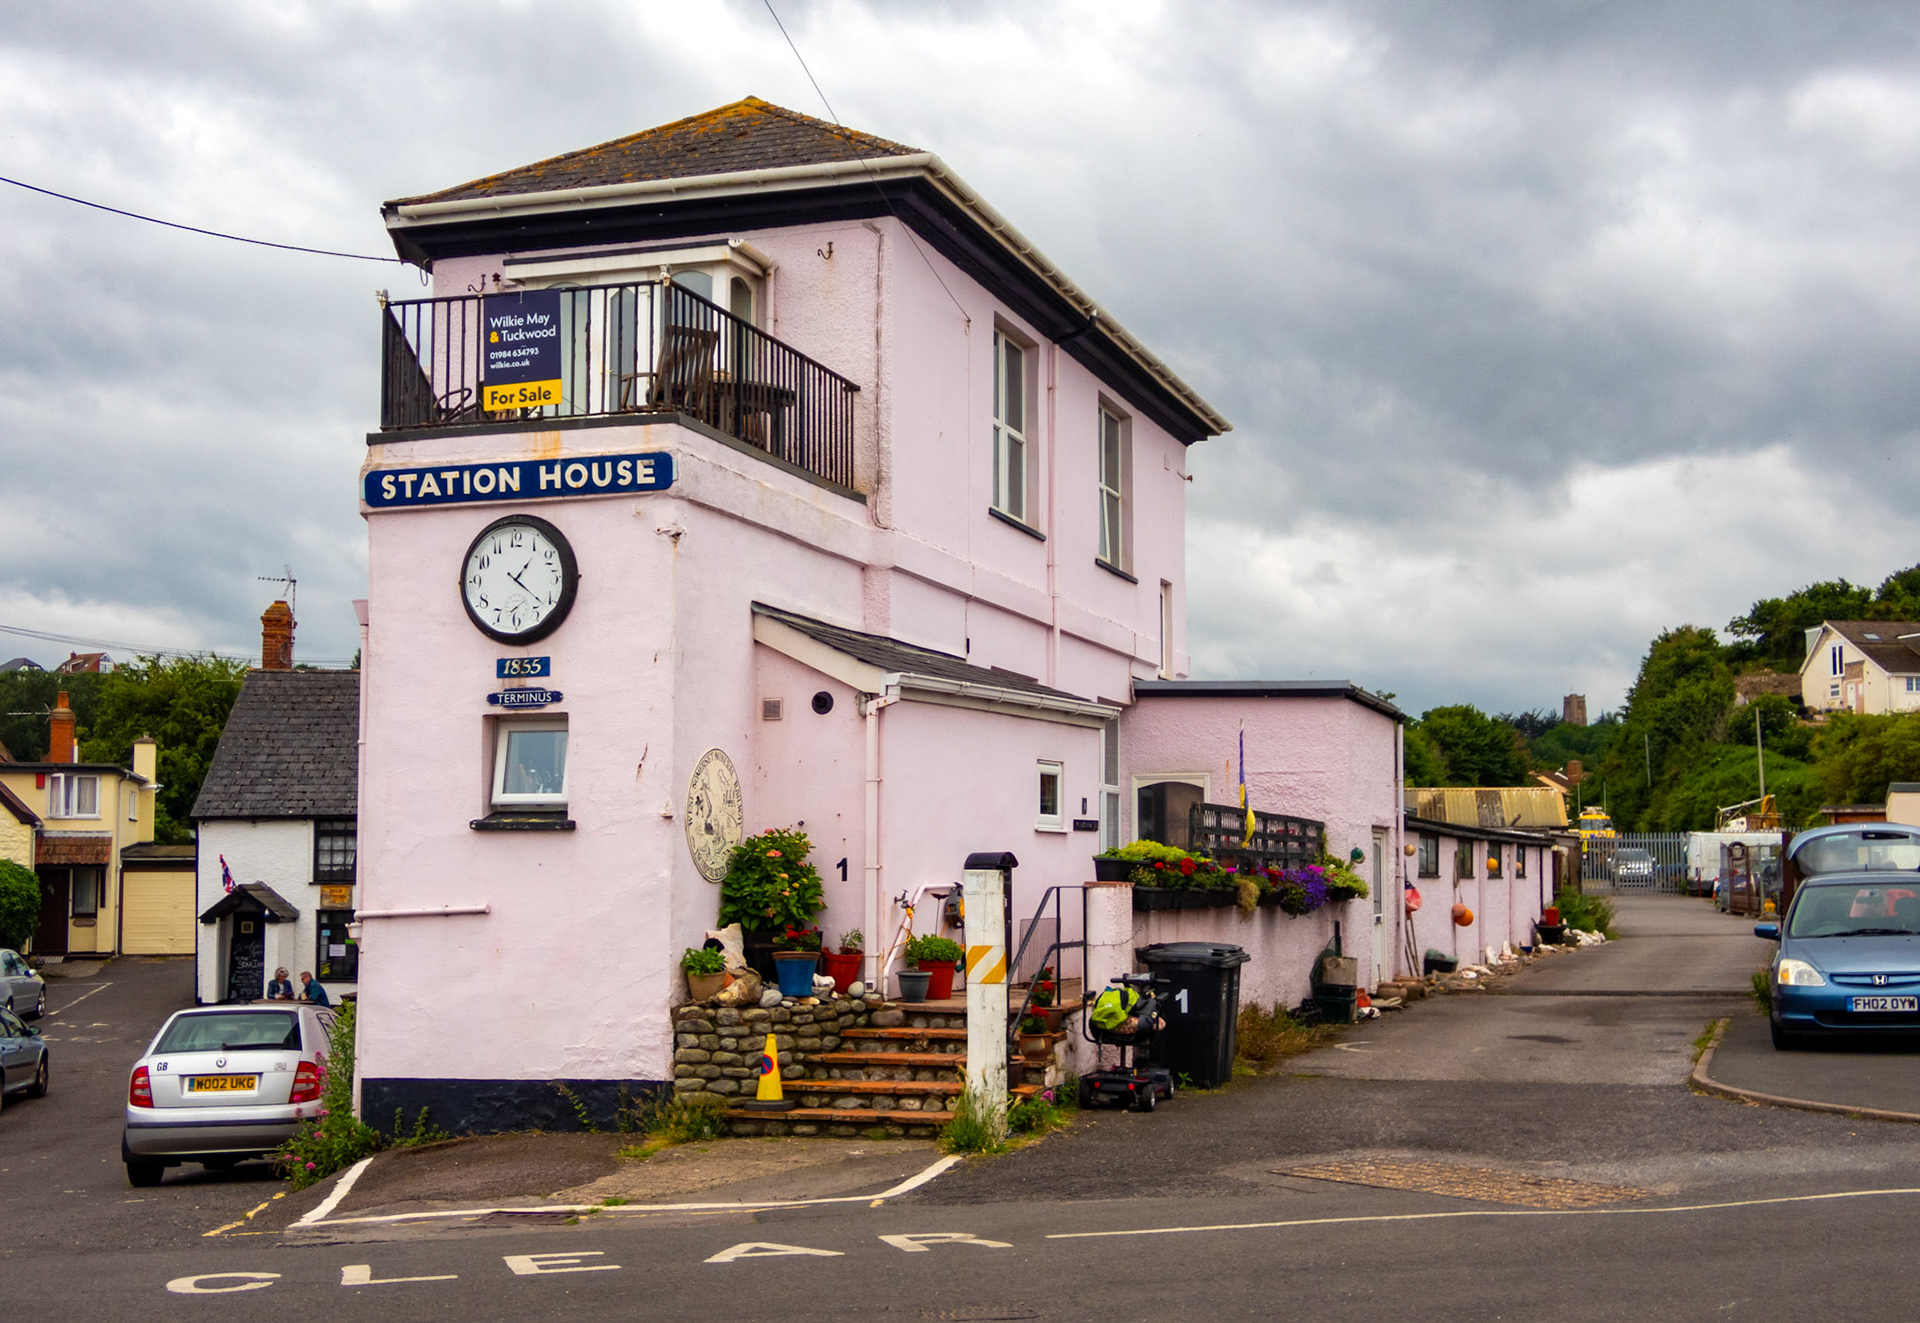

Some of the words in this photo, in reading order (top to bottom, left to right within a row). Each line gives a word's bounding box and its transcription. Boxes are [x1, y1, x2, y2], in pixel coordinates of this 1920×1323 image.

[490, 315, 524, 328] Wilkie
[526, 312, 550, 326] May
[490, 331, 499, 343] &
[501, 324, 556, 342] Tuckwood
[490, 350, 511, 359] 01984
[512, 347, 539, 357] 634793
[490, 359, 530, 369] wilkie.co.uk
[491, 391, 515, 405] For
[519, 386, 551, 403] Sale
[382, 466, 520, 500] STATION
[540, 459, 656, 491] HOUSE
[511, 532, 523, 549] 12
[479, 554, 490, 570] 10
[473, 574, 482, 589] 9
[479, 593, 489, 609] 8
[494, 608, 502, 623] 7
[512, 611, 521, 628] 6
[503, 658, 542, 675] 1855
[497, 692, 552, 704] TERMINUS
[836, 858, 848, 882] 1
[1175, 989, 1188, 1014] 1
[1854, 998, 1887, 1010] FH02
[1891, 998, 1916, 1010] OYW
[157, 1062, 168, 1071] GB
[230, 1077, 254, 1089] UKG
[166, 1231, 1014, 1294] CLEAR
